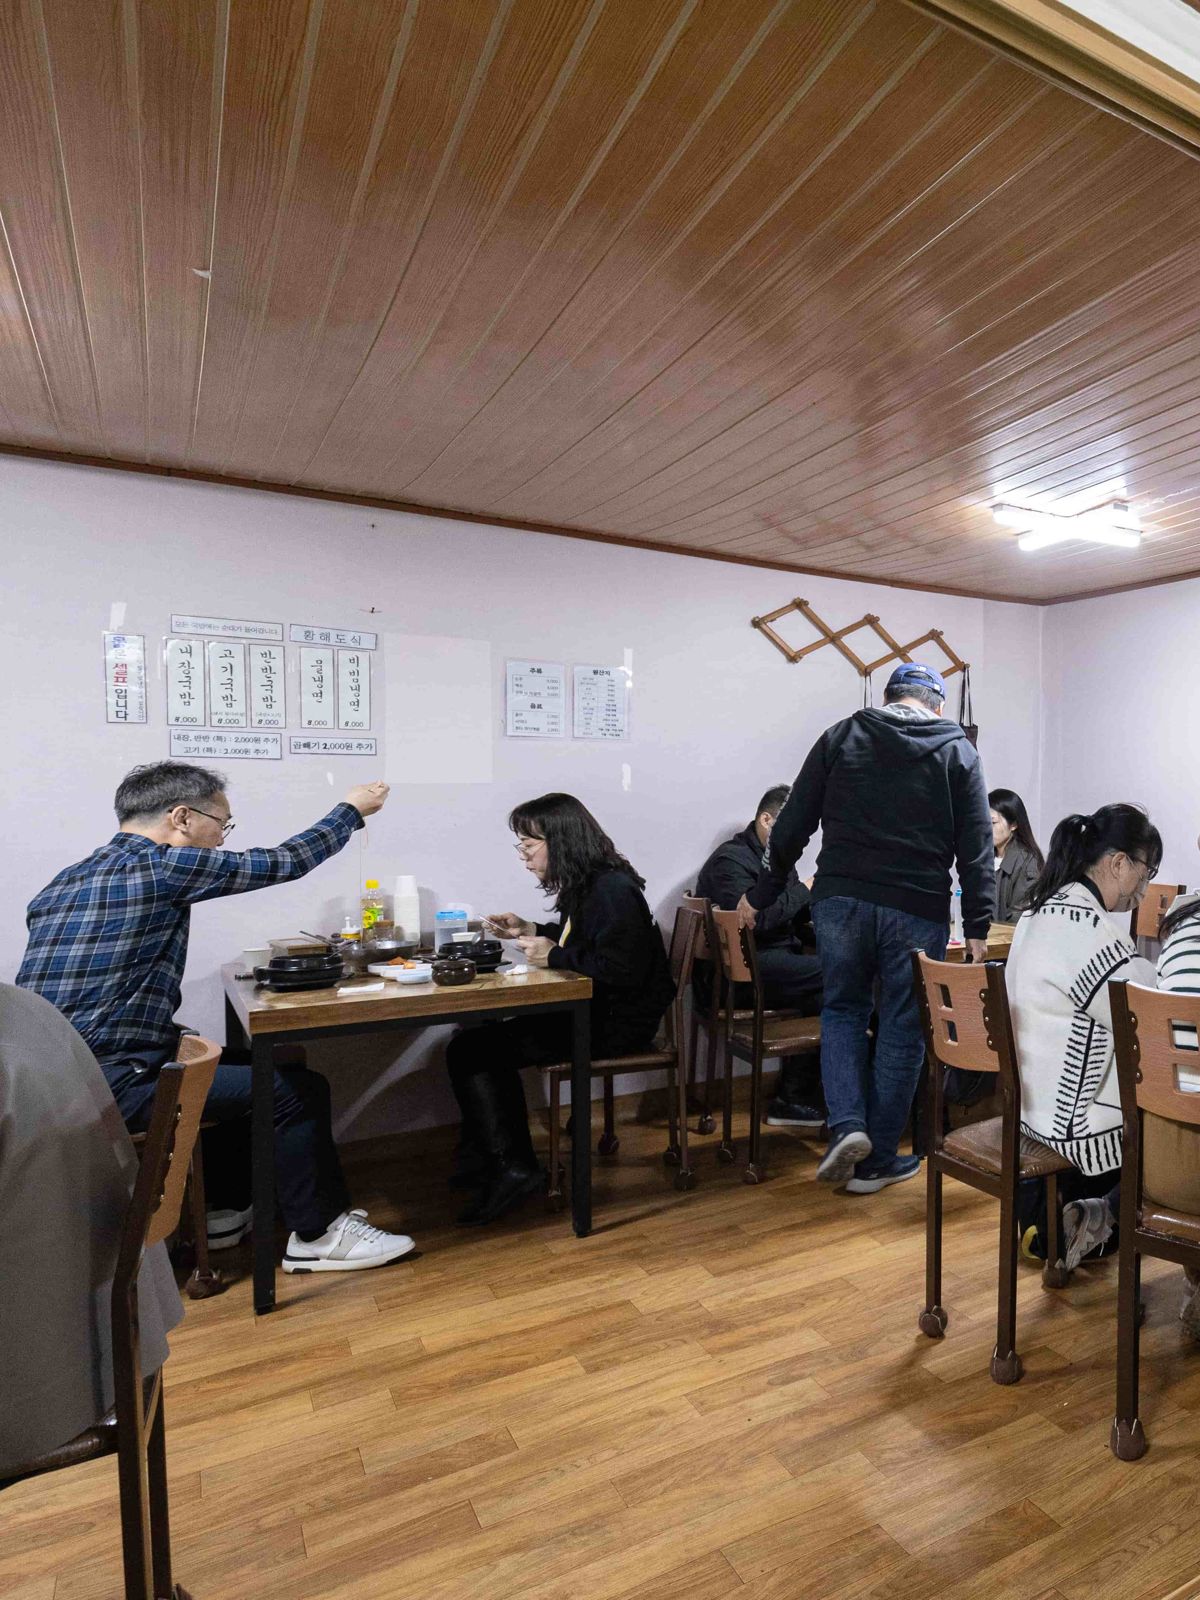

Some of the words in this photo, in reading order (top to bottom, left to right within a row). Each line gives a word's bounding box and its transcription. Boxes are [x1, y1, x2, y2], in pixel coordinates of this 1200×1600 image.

[177, 644, 196, 707] 내장국밥
[219, 648, 238, 709] 고기국밥
[259, 649, 277, 710] 반반국밥
[310, 659, 324, 704] 물냉면
[348, 654, 362, 712] 비빔냉면
[183, 746, 200, 754] 고기
[355, 742, 374, 752] 추가
